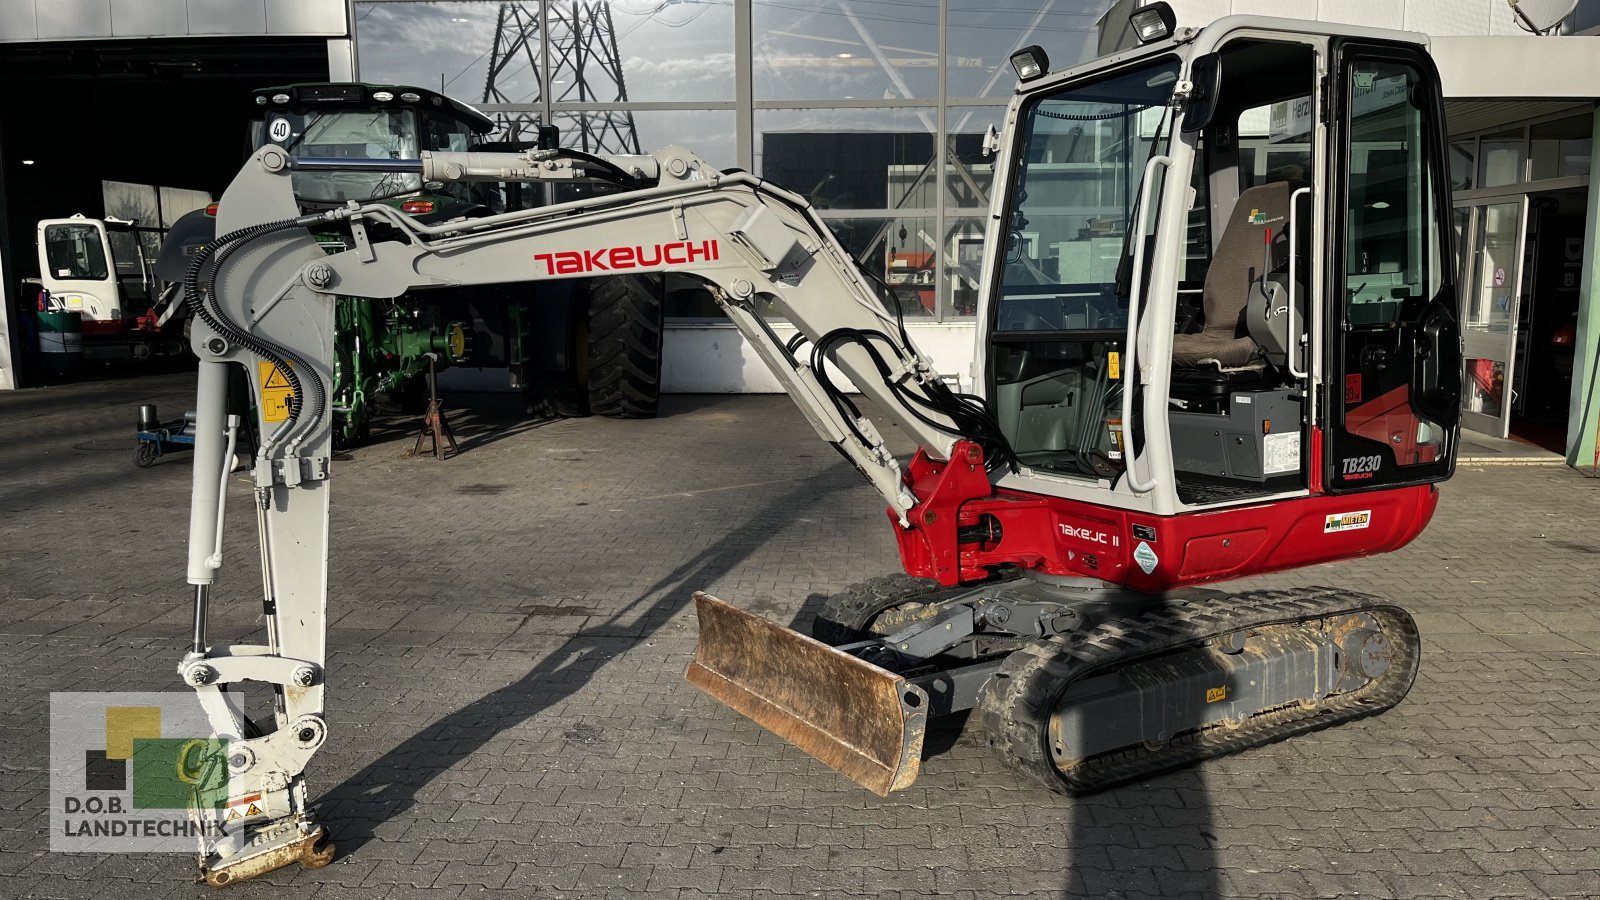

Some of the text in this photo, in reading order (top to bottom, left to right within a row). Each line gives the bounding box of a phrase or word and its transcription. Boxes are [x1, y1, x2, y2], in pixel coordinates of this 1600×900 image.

[273, 123, 286, 137] 40
[534, 240, 719, 275] TAKEUCHI
[1342, 455, 1382, 474] TB230
[1341, 513, 1369, 526] MIETEN
